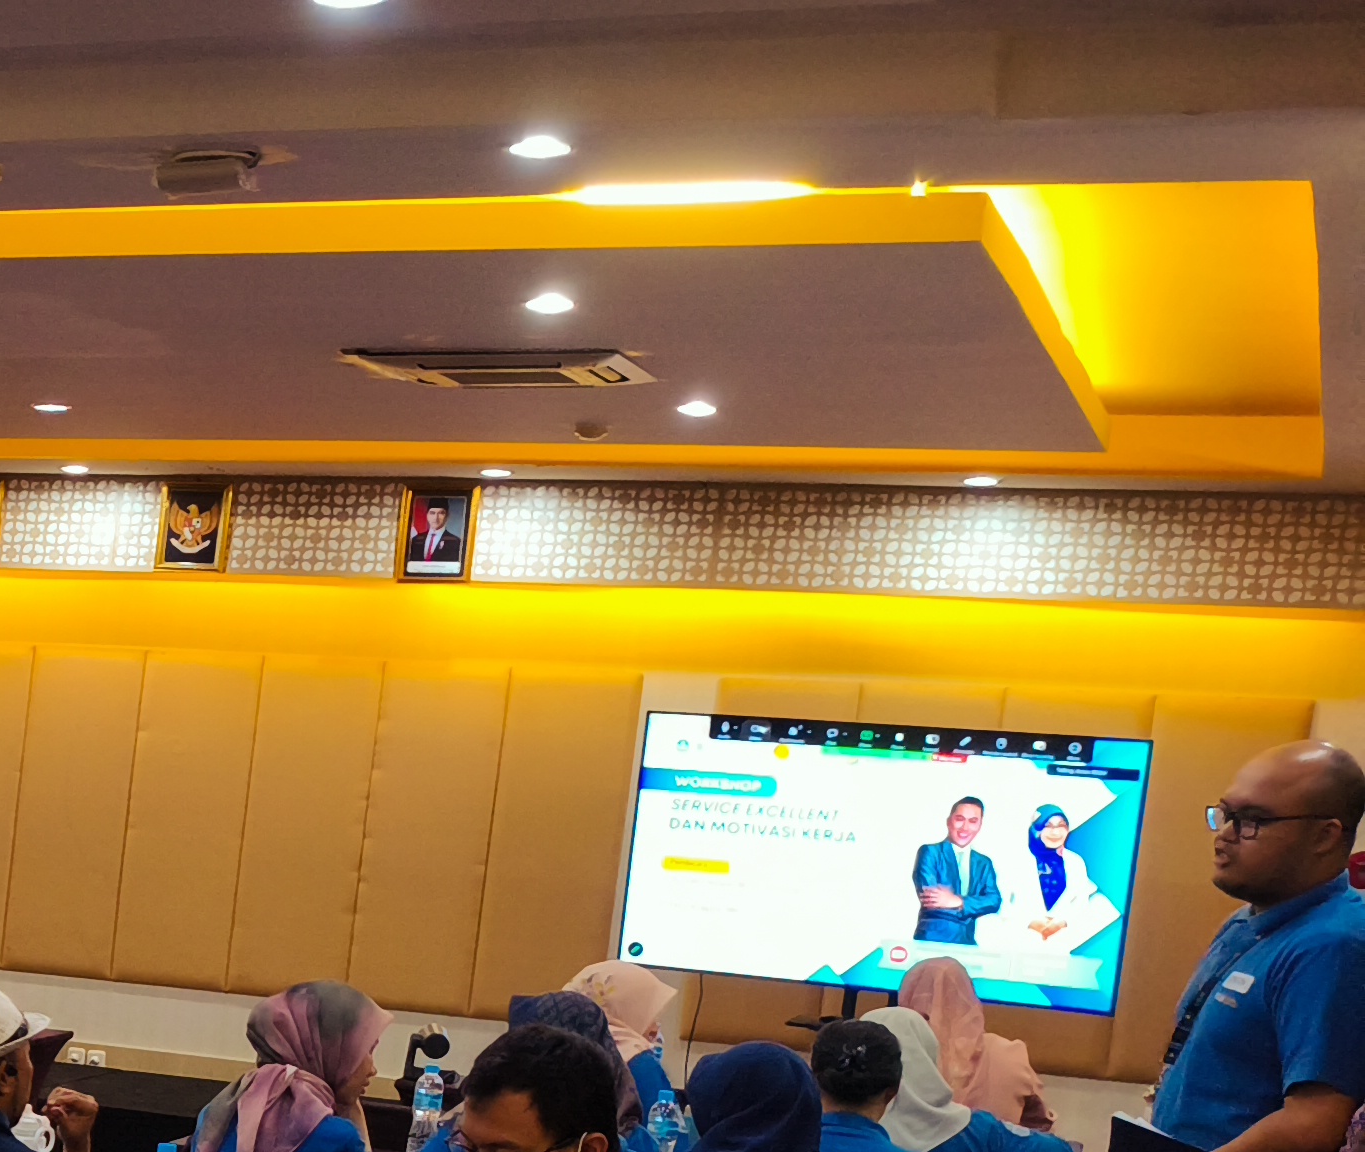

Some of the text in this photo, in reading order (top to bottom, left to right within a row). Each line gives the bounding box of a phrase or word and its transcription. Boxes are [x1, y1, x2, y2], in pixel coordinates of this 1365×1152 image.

[674, 775, 762, 793] WORKSHOP
[671, 798, 839, 821] SERVICE EXCELLENT
[669, 817, 856, 843] DAN MOTIVASI KERJA
